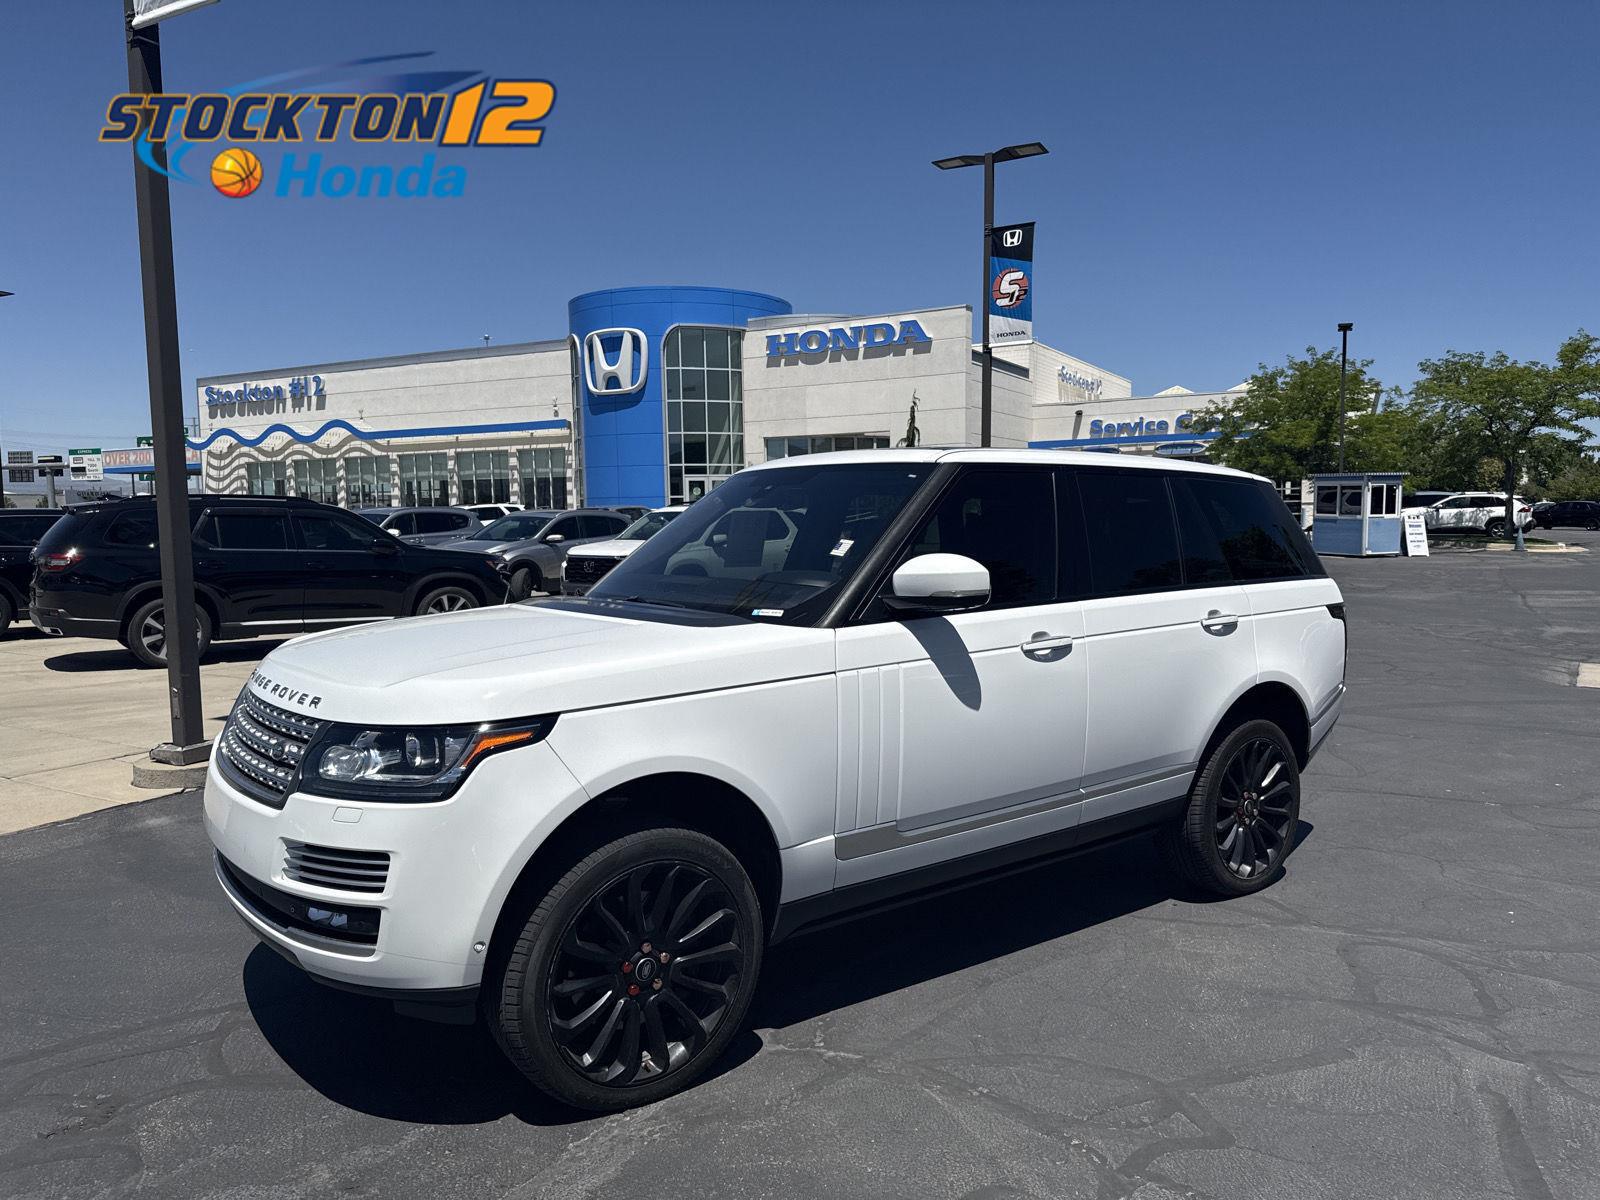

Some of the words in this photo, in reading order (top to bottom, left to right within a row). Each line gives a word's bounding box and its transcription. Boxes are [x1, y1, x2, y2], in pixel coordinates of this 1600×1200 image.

[765, 319, 933, 358] HONDA
[996, 330, 1027, 338] HONDA
[204, 383, 284, 404] Stockton
[288, 375, 326, 398] #12
[1090, 416, 1169, 436] Service
[103, 453, 131, 466] OVER
[250, 668, 272, 690] ANGE
[270, 683, 322, 709] ROVER
